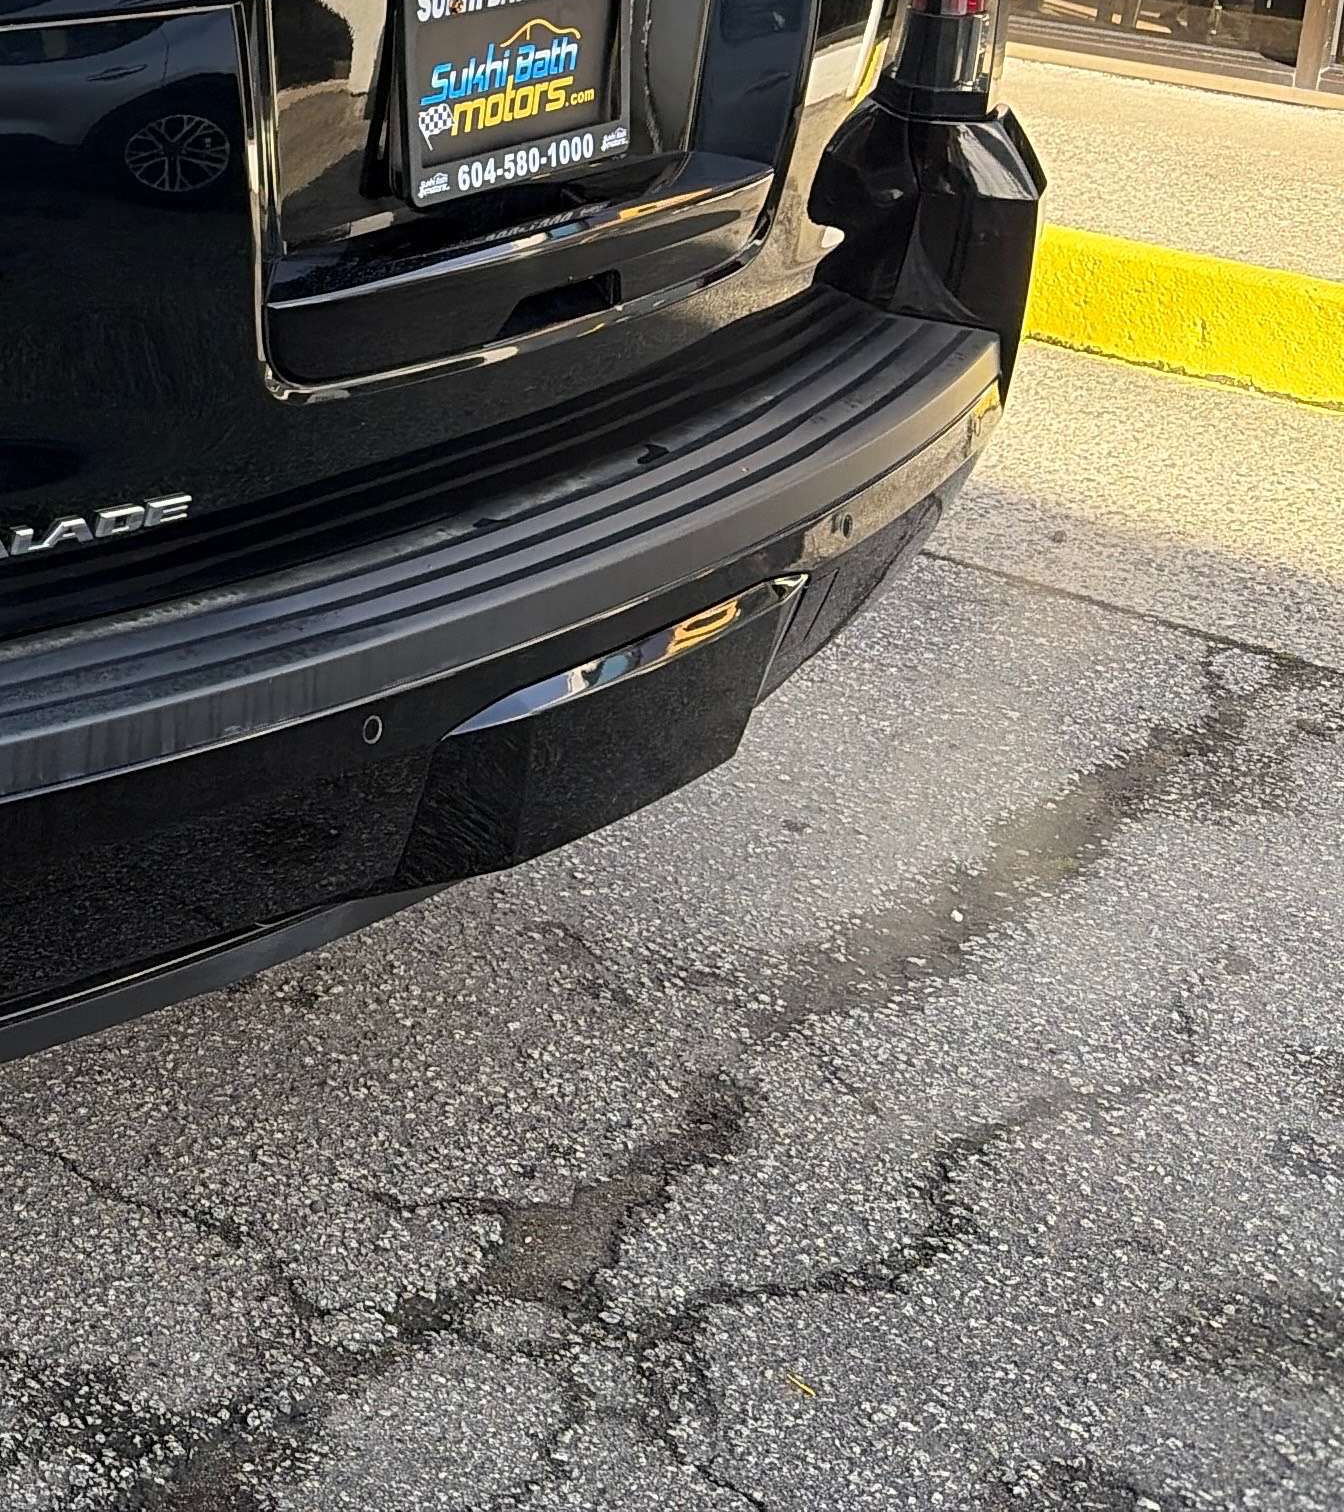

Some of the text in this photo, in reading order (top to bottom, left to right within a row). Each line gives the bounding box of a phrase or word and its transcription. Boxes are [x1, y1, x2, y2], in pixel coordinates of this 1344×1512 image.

[420, 36, 579, 105] Sukhi Bath
[457, 133, 594, 191] 604-580-1000
